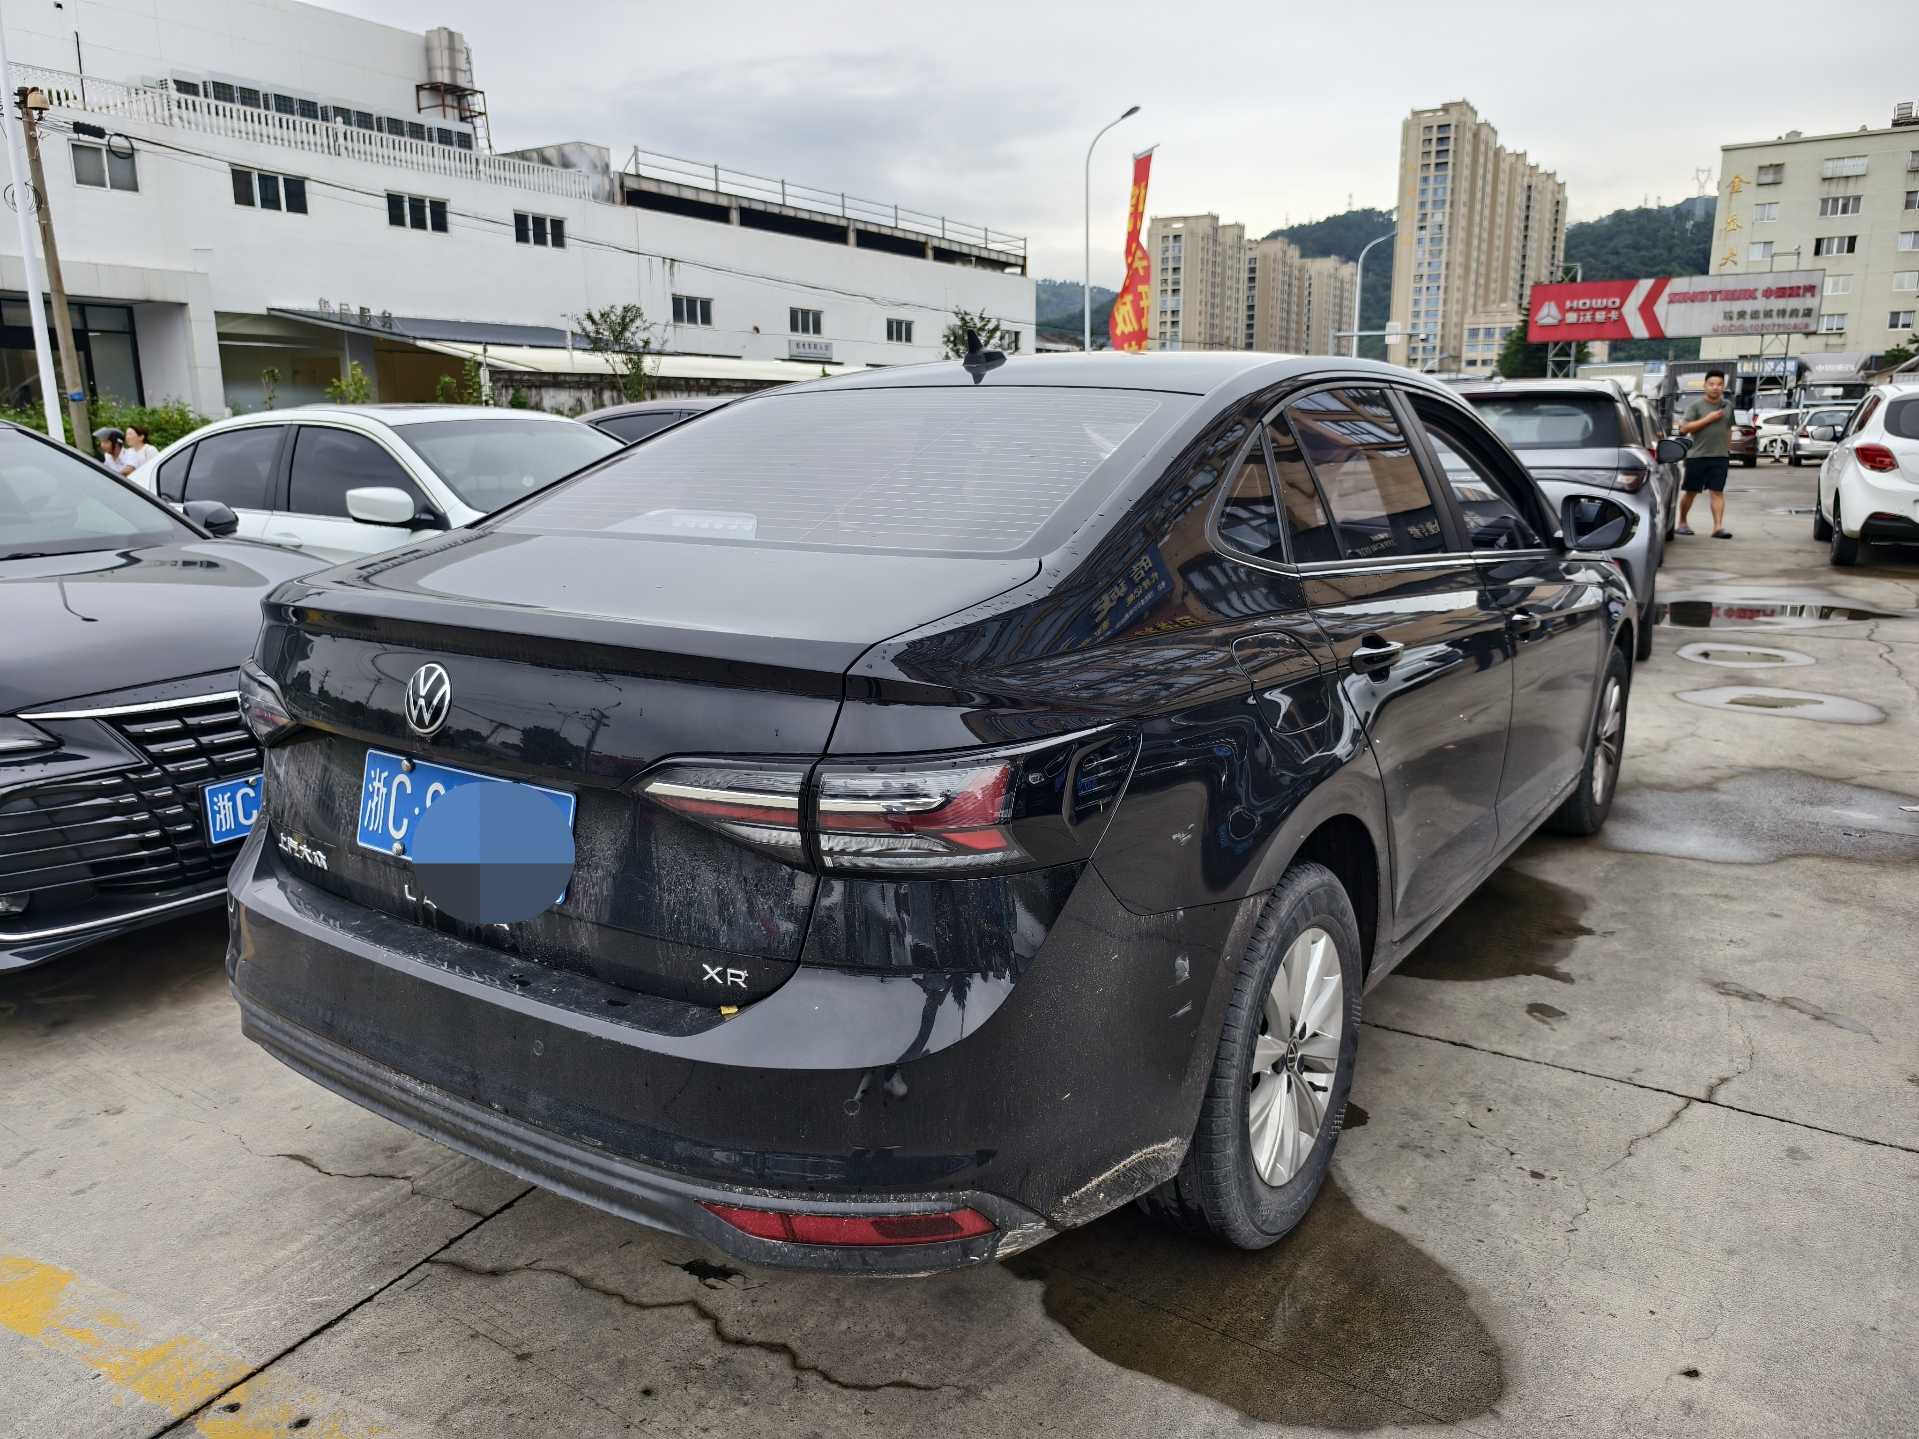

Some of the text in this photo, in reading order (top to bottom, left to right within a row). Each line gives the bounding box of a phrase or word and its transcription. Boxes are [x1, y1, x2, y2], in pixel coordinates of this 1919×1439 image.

[1565, 298, 1621, 310] HOWO
[278, 832, 329, 871] 上汽大众
